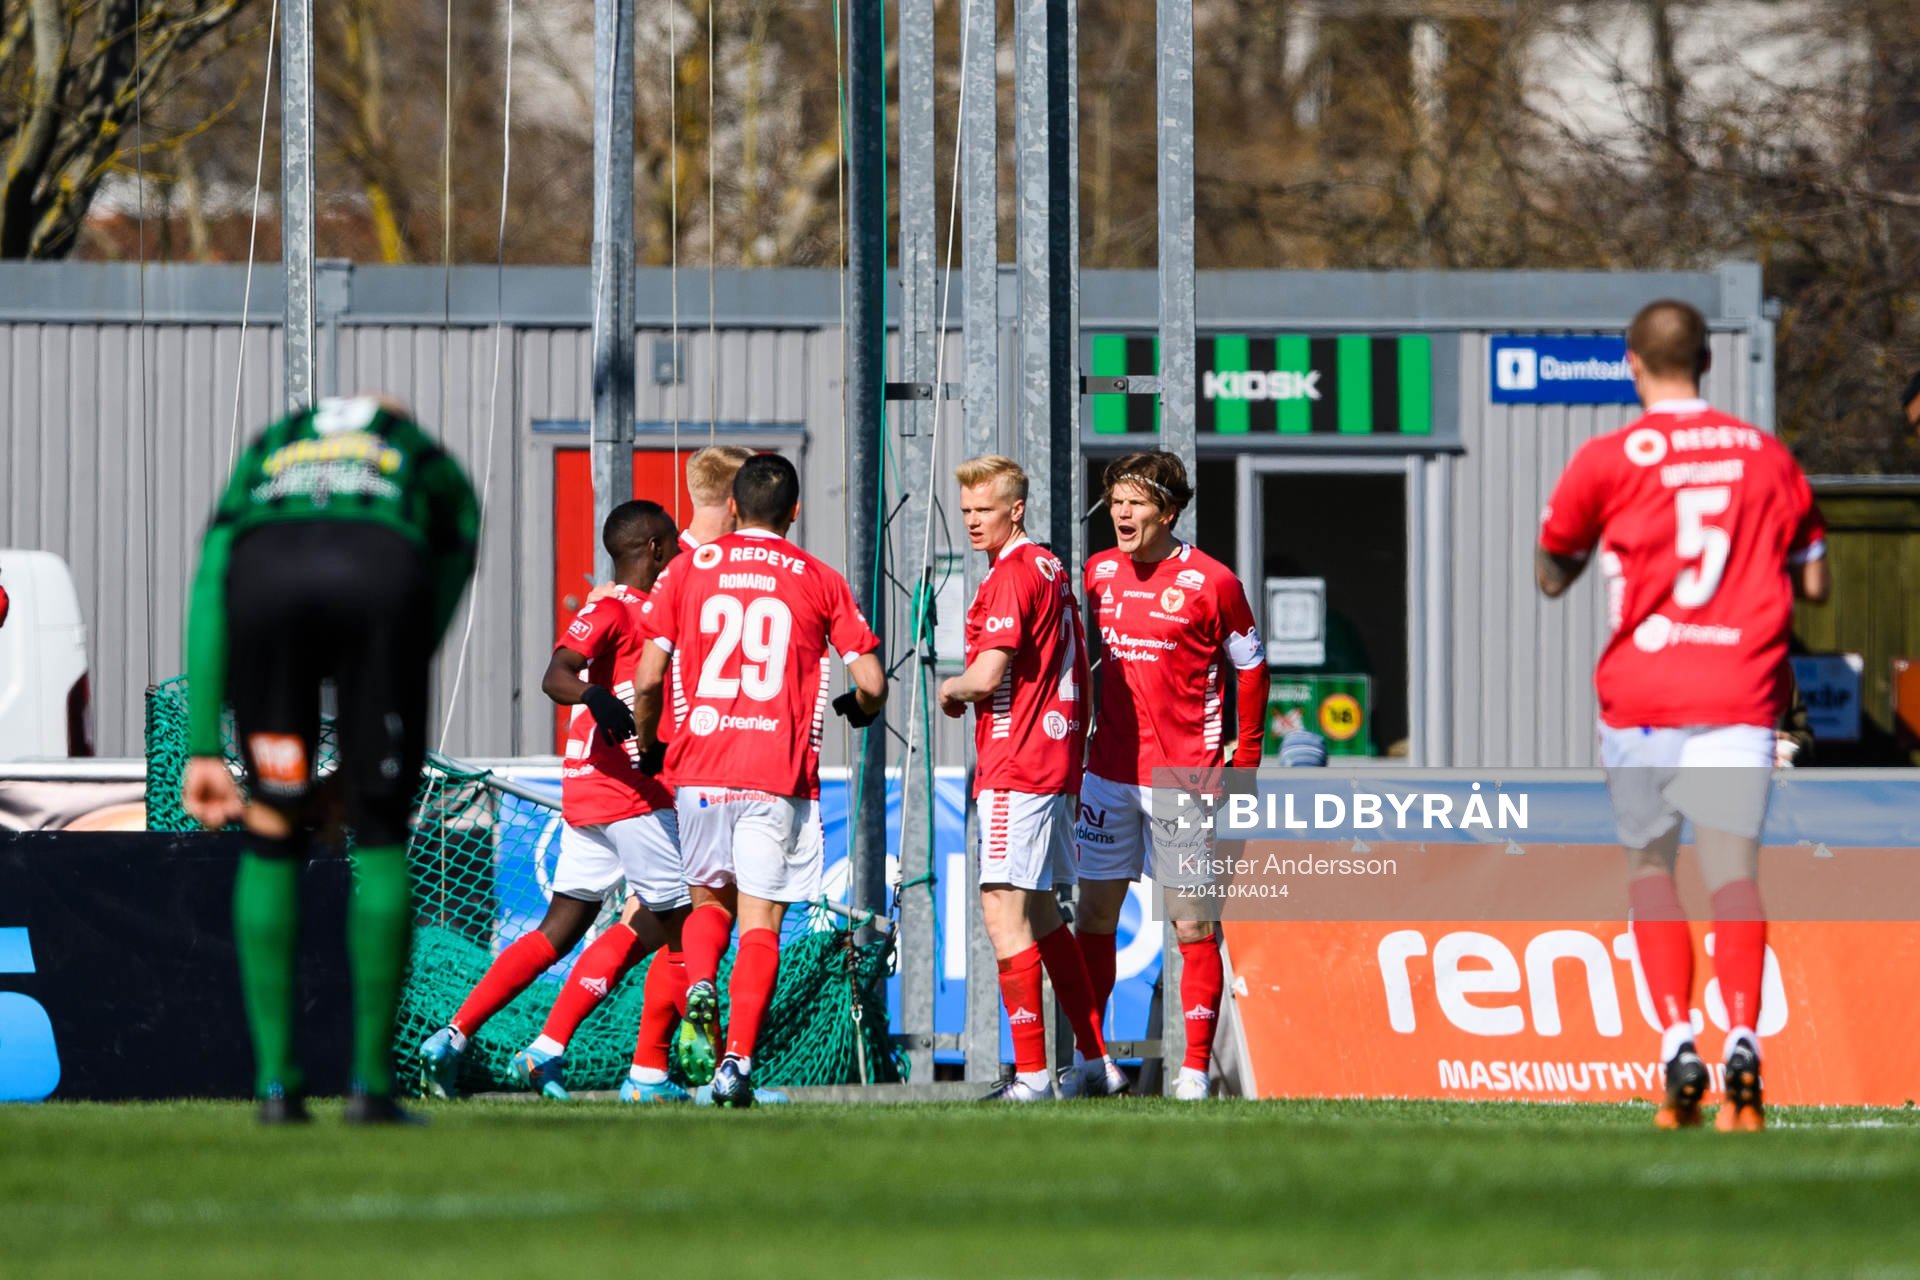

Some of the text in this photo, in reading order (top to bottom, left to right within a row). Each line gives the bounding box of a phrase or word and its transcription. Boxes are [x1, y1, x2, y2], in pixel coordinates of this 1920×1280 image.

[1203, 370, 1321, 400] KIOSK
[1672, 486, 1731, 609] 5
[729, 546, 806, 575] REDEYE
[718, 573, 776, 592] ROMARIO
[985, 616, 1014, 632] Ove
[695, 594, 792, 701] 29
[1120, 634, 1178, 651] Supermarket
[719, 714, 778, 732] premier
[1075, 826, 1115, 845] ybloms
